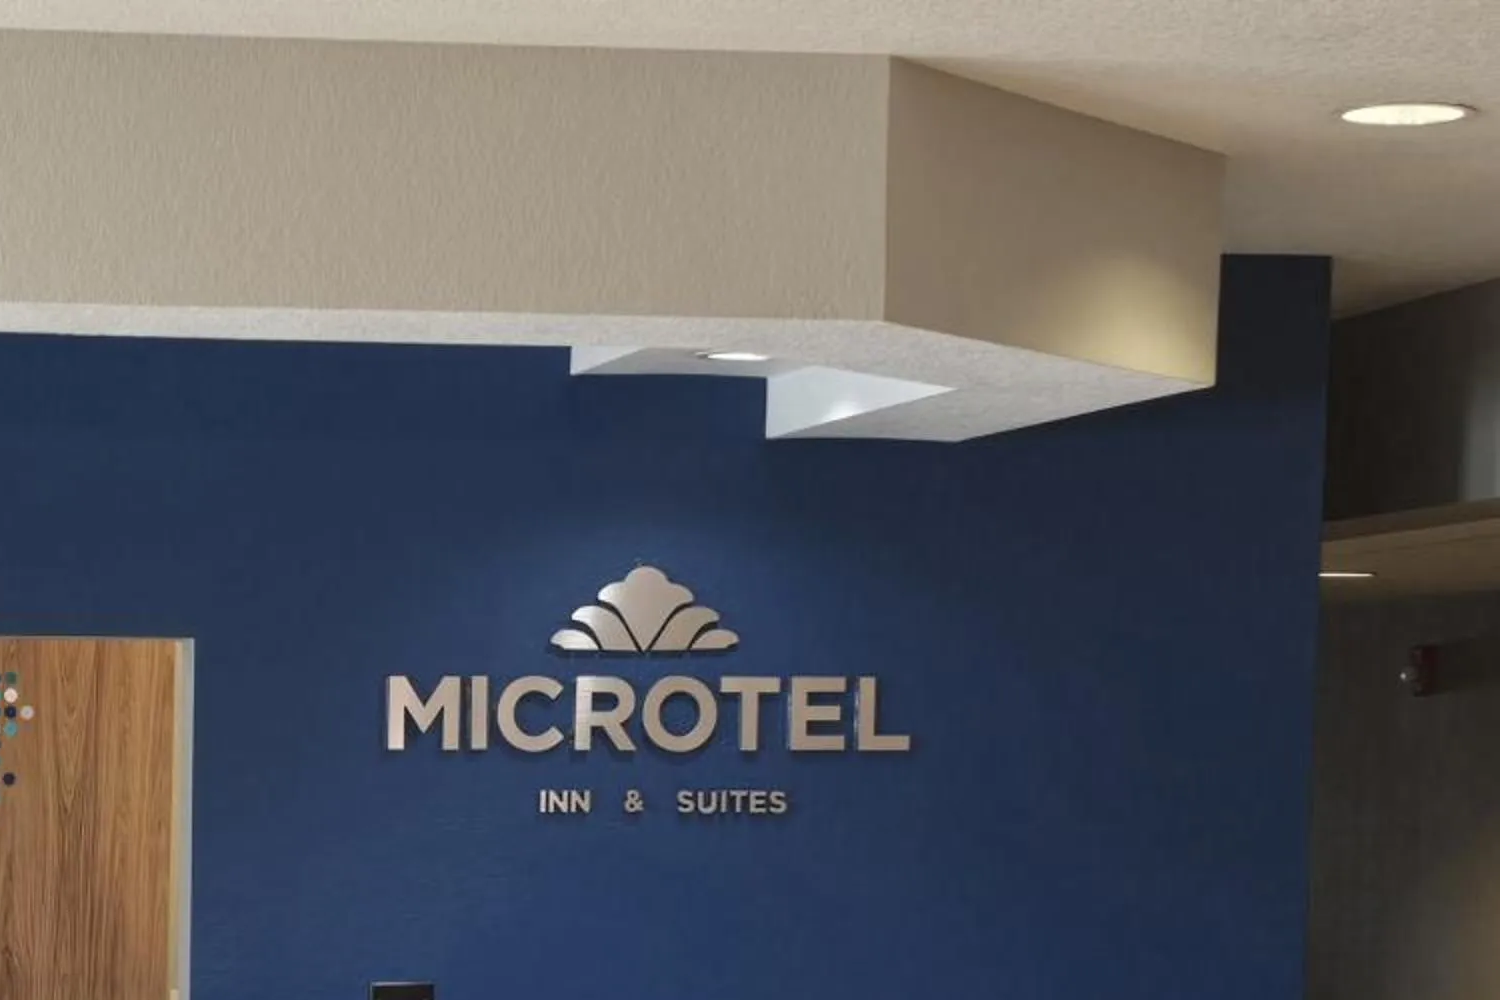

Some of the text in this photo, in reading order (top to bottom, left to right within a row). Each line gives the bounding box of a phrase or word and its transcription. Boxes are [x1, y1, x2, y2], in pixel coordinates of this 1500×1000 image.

[387, 674, 911, 753] MICROTEL
[539, 789, 788, 815] INN & SUITES
